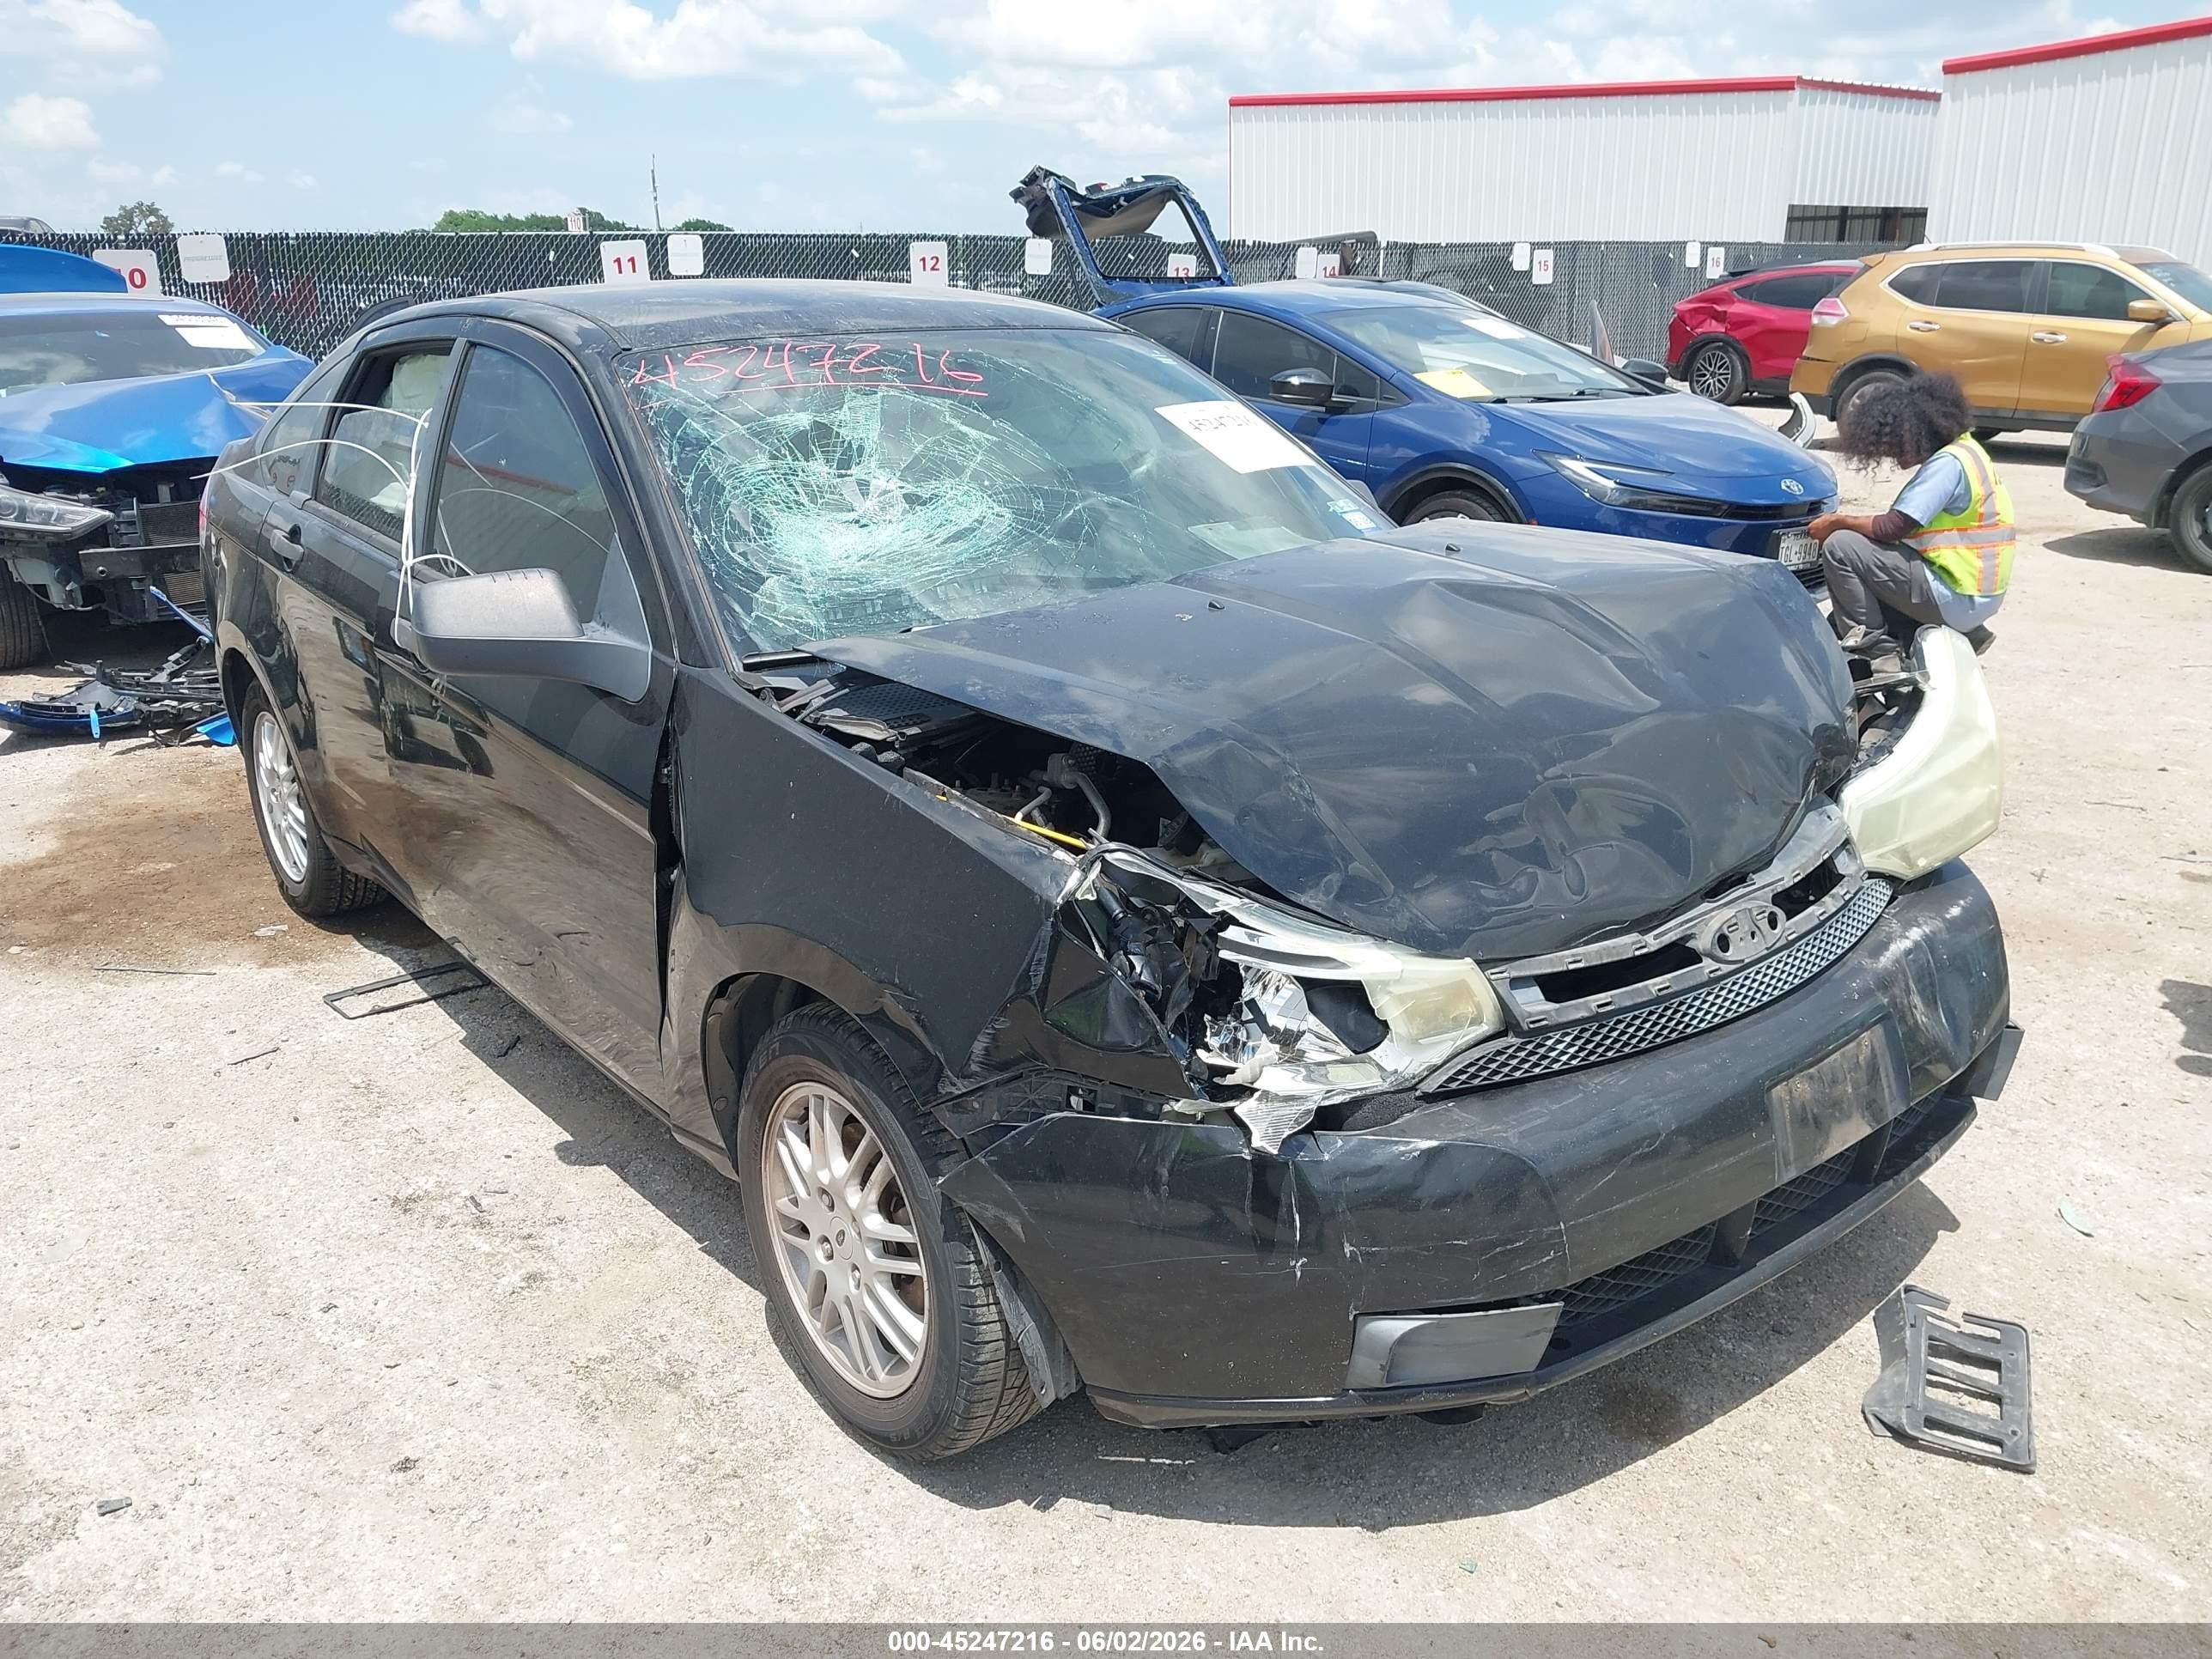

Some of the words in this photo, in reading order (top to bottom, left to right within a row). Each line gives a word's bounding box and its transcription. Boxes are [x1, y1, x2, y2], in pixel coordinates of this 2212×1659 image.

[613, 256, 637, 274] 11
[919, 256, 940, 272] 12
[1538, 260, 1549, 272] 15
[1711, 257, 1721, 268] 16
[1174, 266, 1190, 277] 13
[1322, 265, 1337, 278] 14
[633, 340, 984, 390] 45247216
